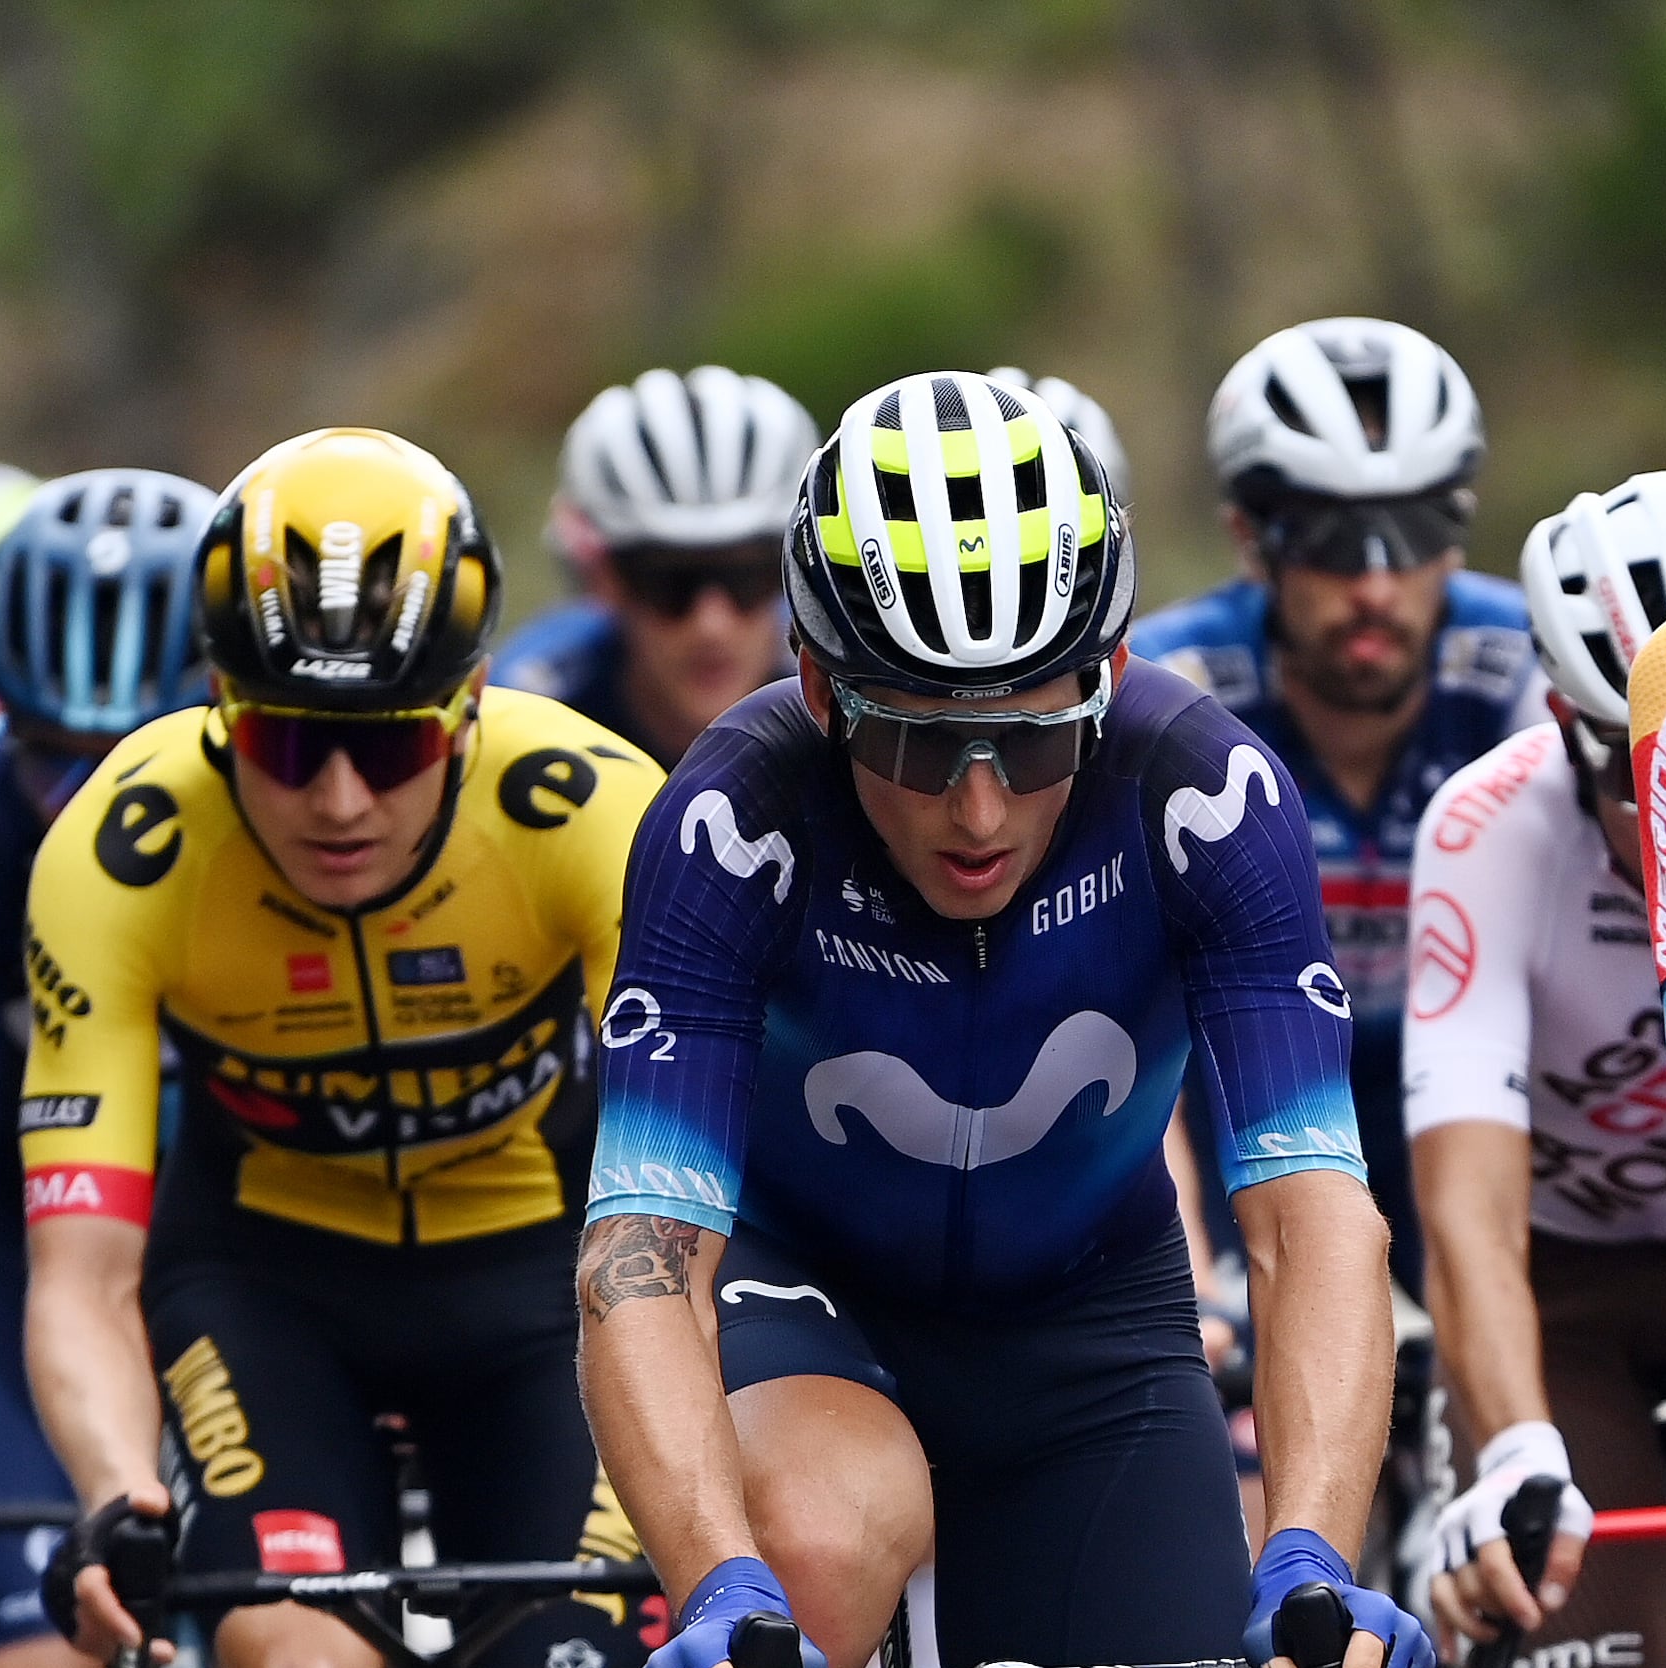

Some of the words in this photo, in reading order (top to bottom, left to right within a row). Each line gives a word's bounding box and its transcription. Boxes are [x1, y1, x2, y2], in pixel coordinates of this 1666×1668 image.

[865, 547, 892, 602] ABUS
[1058, 530, 1074, 589] ABUS
[289, 658, 373, 680] LAZER
[959, 687, 1007, 698] ABUS
[869, 886, 885, 902] UC
[1032, 850, 1124, 937] GOBIK
[815, 928, 951, 985] CANYON
[25, 1170, 104, 1211] MA
